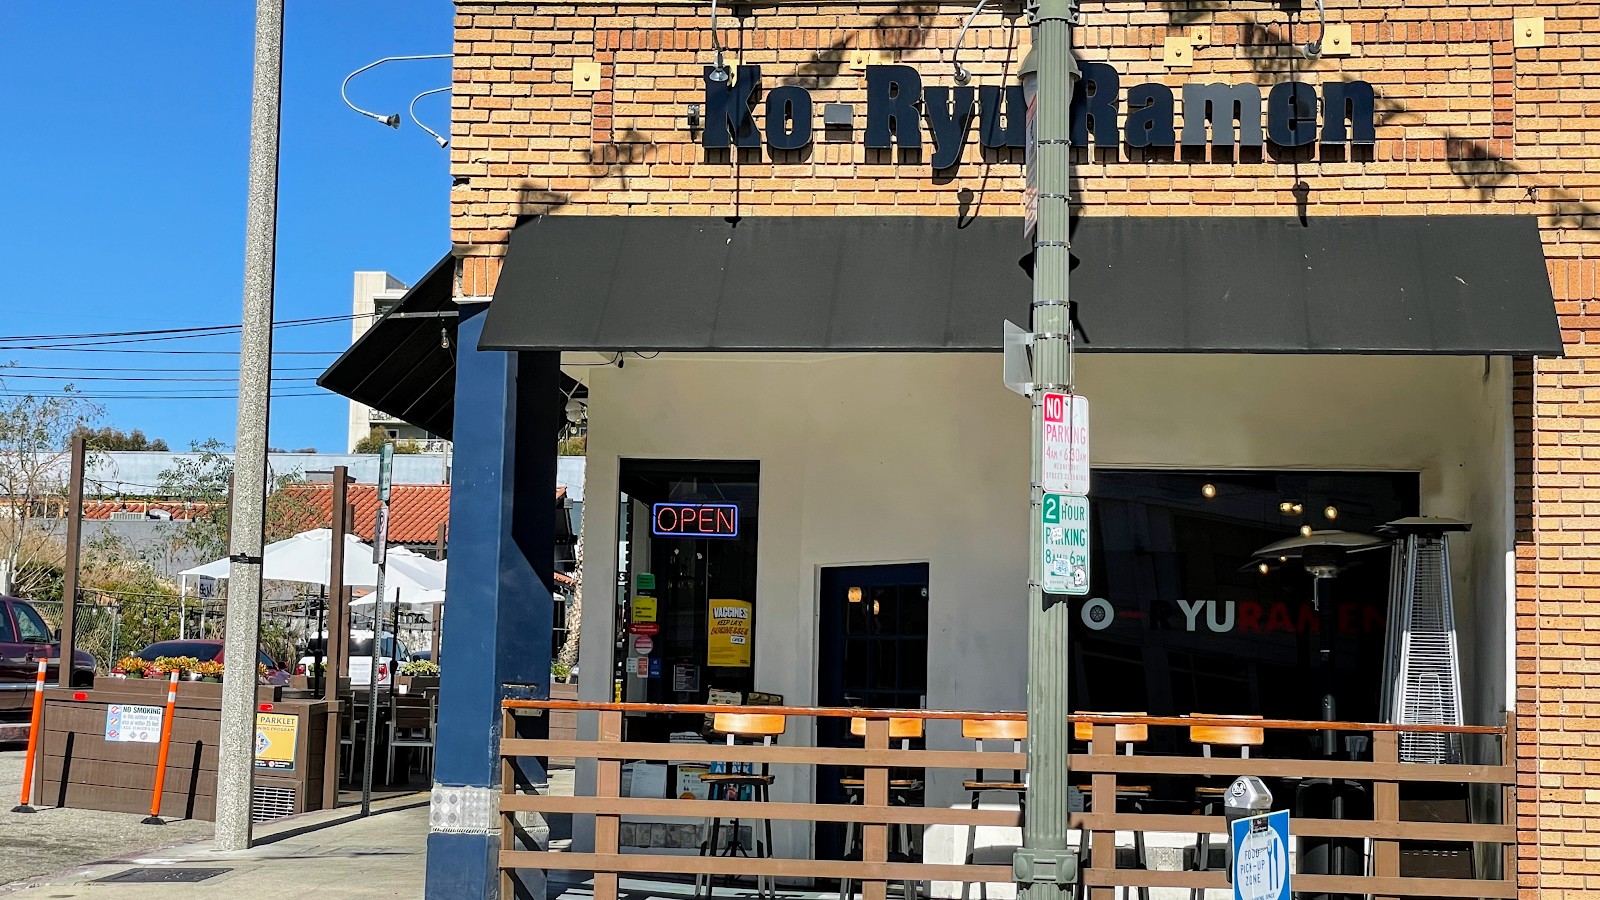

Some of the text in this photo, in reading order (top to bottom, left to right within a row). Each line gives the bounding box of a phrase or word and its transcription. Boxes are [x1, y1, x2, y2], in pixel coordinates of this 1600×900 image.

[1070, 63, 1376, 147] Ramen
[1046, 397, 1061, 419] NO
[1046, 424, 1086, 445] PARKING
[1045, 498, 1085, 521] 2 HOUR
[657, 506, 734, 533] OPEN
[713, 606, 748, 619] VACCINES
[133, 706, 161, 715] SMOKING
[260, 716, 296, 725] PARKLET
[1244, 848, 1260, 860] FOOD
[1240, 859, 1266, 875] PICK-UP
[1245, 873, 1261, 886] ZONE
